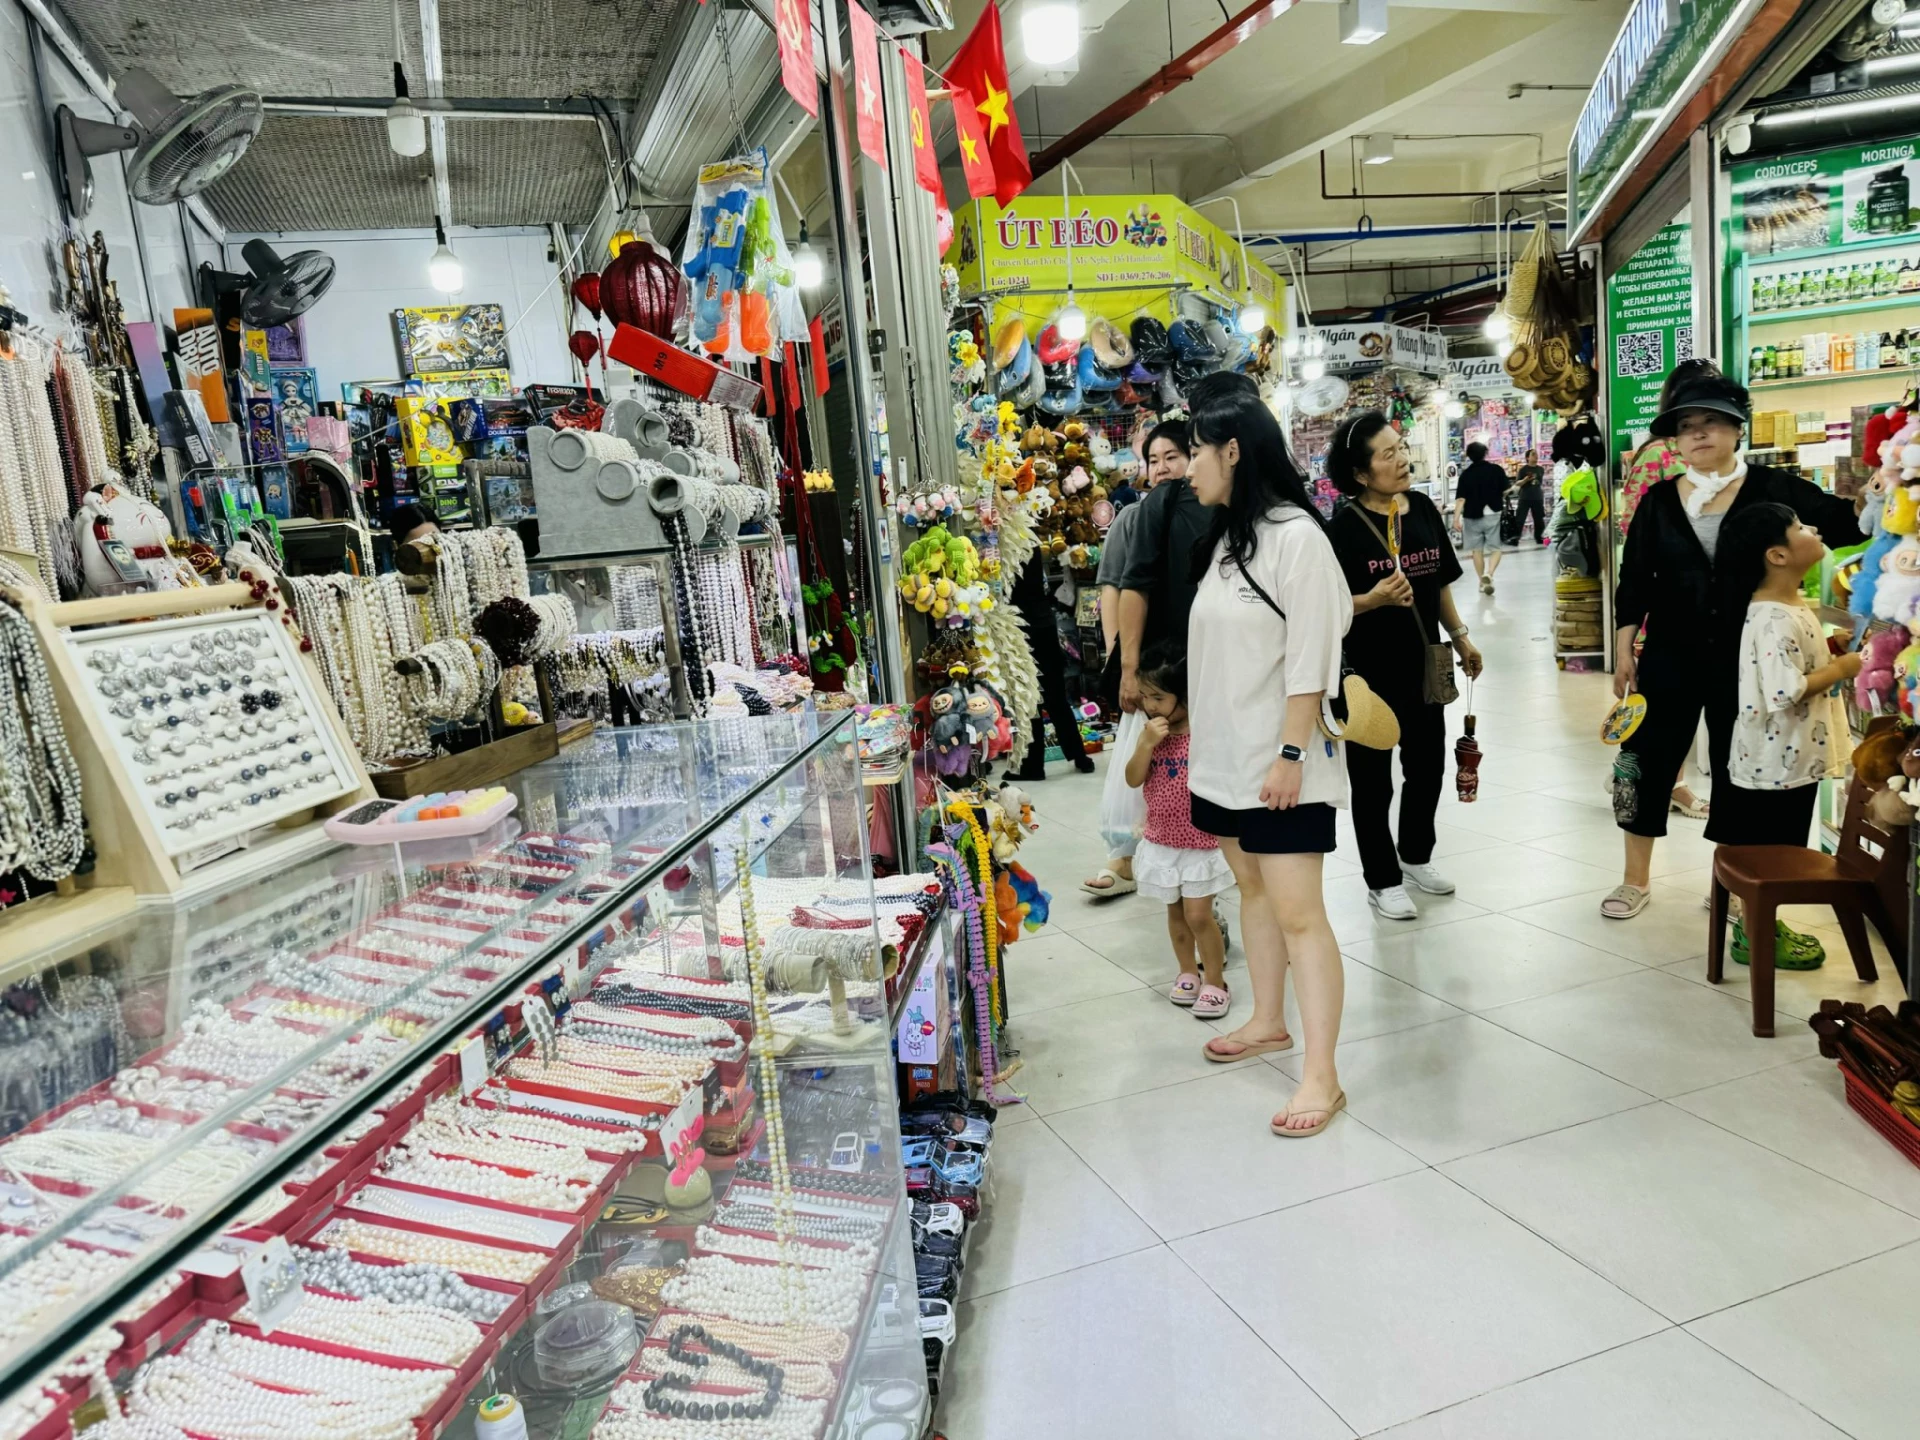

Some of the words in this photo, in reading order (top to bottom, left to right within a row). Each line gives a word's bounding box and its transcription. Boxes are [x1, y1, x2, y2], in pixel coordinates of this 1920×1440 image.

[1578, 51, 1617, 175] PHARMACY
[1754, 159, 1818, 180] CORDYCEPS
[1861, 144, 1916, 163] MORINGA
[995, 210, 1044, 249] ÚT
[1049, 210, 1119, 249] BÉO
[1631, 246, 1668, 259] МЕНДУЕМ
[1629, 257, 1674, 271] ПРЕПАРАТЫ
[1617, 266, 1690, 284] ЛИЦЕНЗИРОВАННЫХ
[1616, 284, 1640, 295] ЧТОБЫ
[1642, 278, 1680, 291] ИЗБЕЖАТЬ
[1622, 295, 1655, 307] ЖЕЛАЕМ
[1657, 293, 1673, 302] ВАМ
[1675, 290, 1692, 301] ЗДО
[1616, 311, 1622, 319] И
[1624, 302, 1681, 318] ЕСТЕСТВЕННОЙ
[1626, 317, 1675, 331] ПРИНИМАЕМ
[1319, 328, 1356, 345] Ngân
[197, 324, 221, 377] AUTO
[653, 351, 668, 371] M9
[1448, 359, 1501, 380] Ngân
[440, 498, 457, 507] DINO
